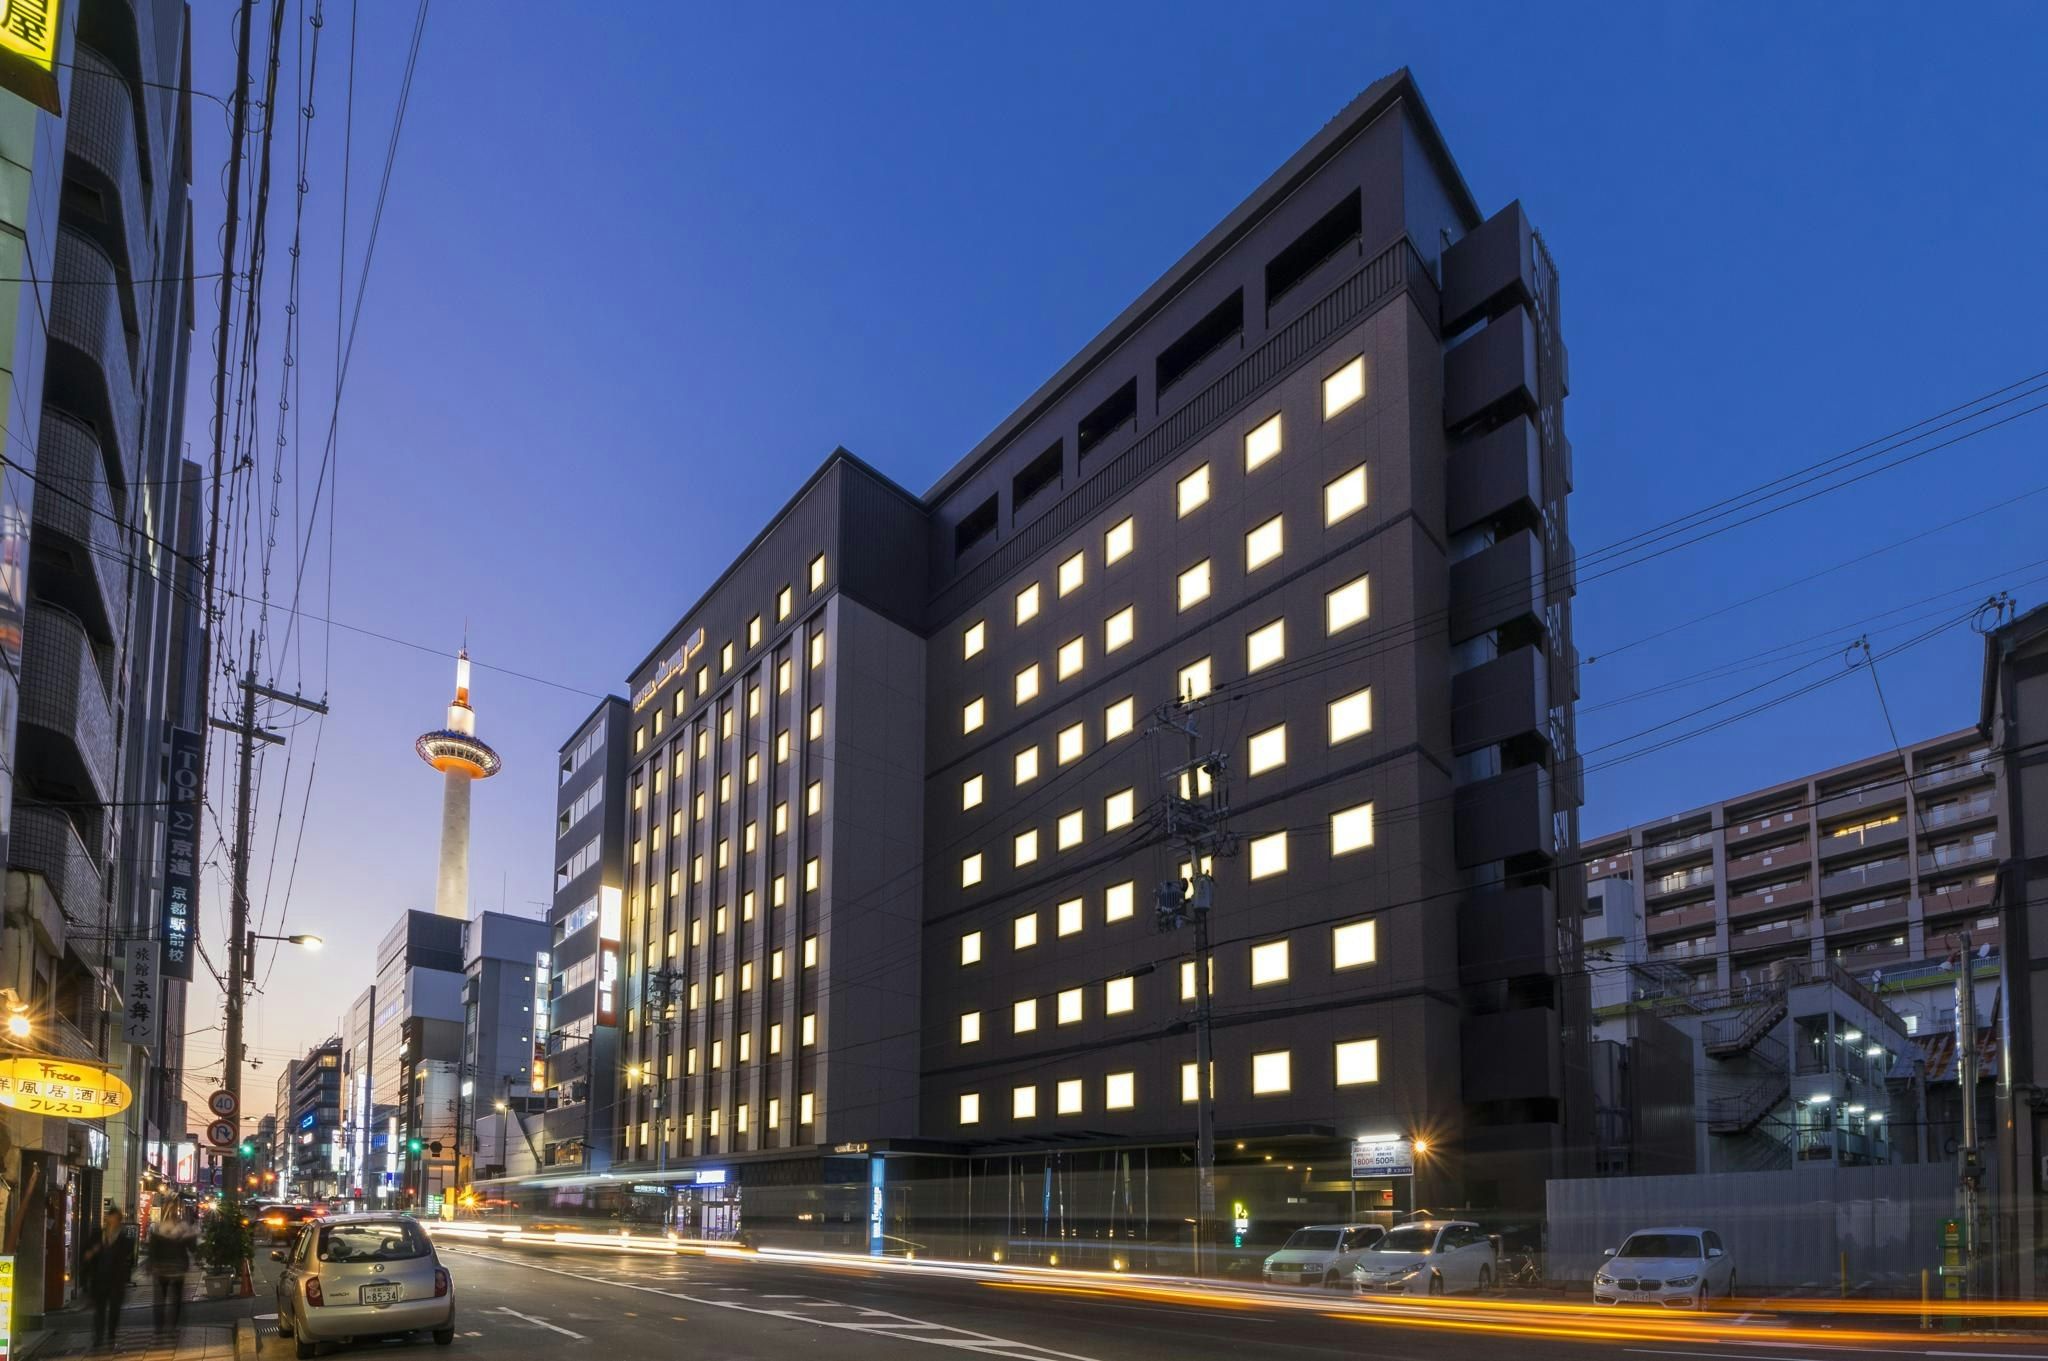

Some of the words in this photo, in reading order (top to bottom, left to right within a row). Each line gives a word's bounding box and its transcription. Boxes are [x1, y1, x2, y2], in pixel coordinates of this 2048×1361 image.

[38, 1062, 81, 1082] Fresco
[30, 1099, 83, 1114] フレスコ
[215, 1097, 233, 1110] 40
[372, 1292, 396, 1302] 85-34
